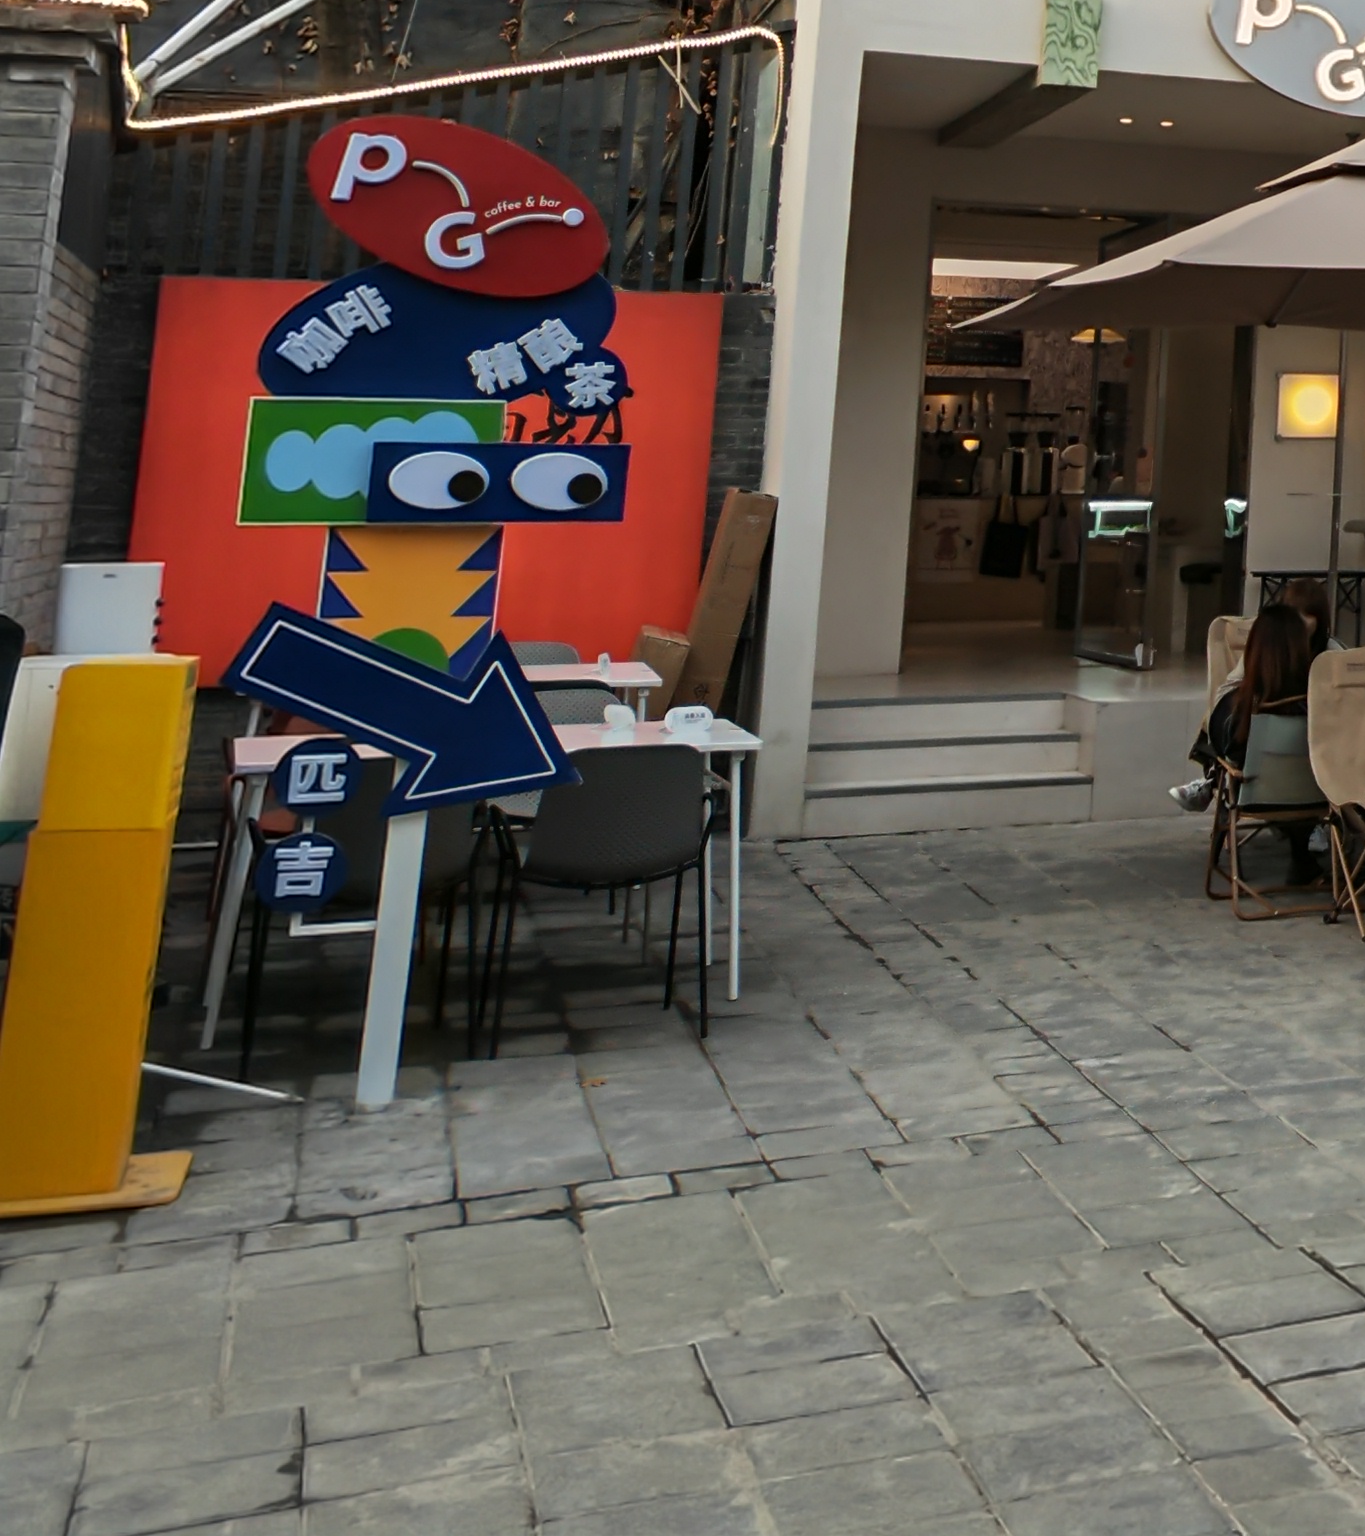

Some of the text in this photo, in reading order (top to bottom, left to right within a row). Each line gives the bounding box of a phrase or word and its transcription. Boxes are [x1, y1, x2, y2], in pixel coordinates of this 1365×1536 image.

[330, 132, 485, 270] P G
[483, 197, 522, 219] coffee
[538, 195, 562, 209] bar
[275, 283, 393, 375] 咖啡
[273, 751, 348, 899] 匹吉
